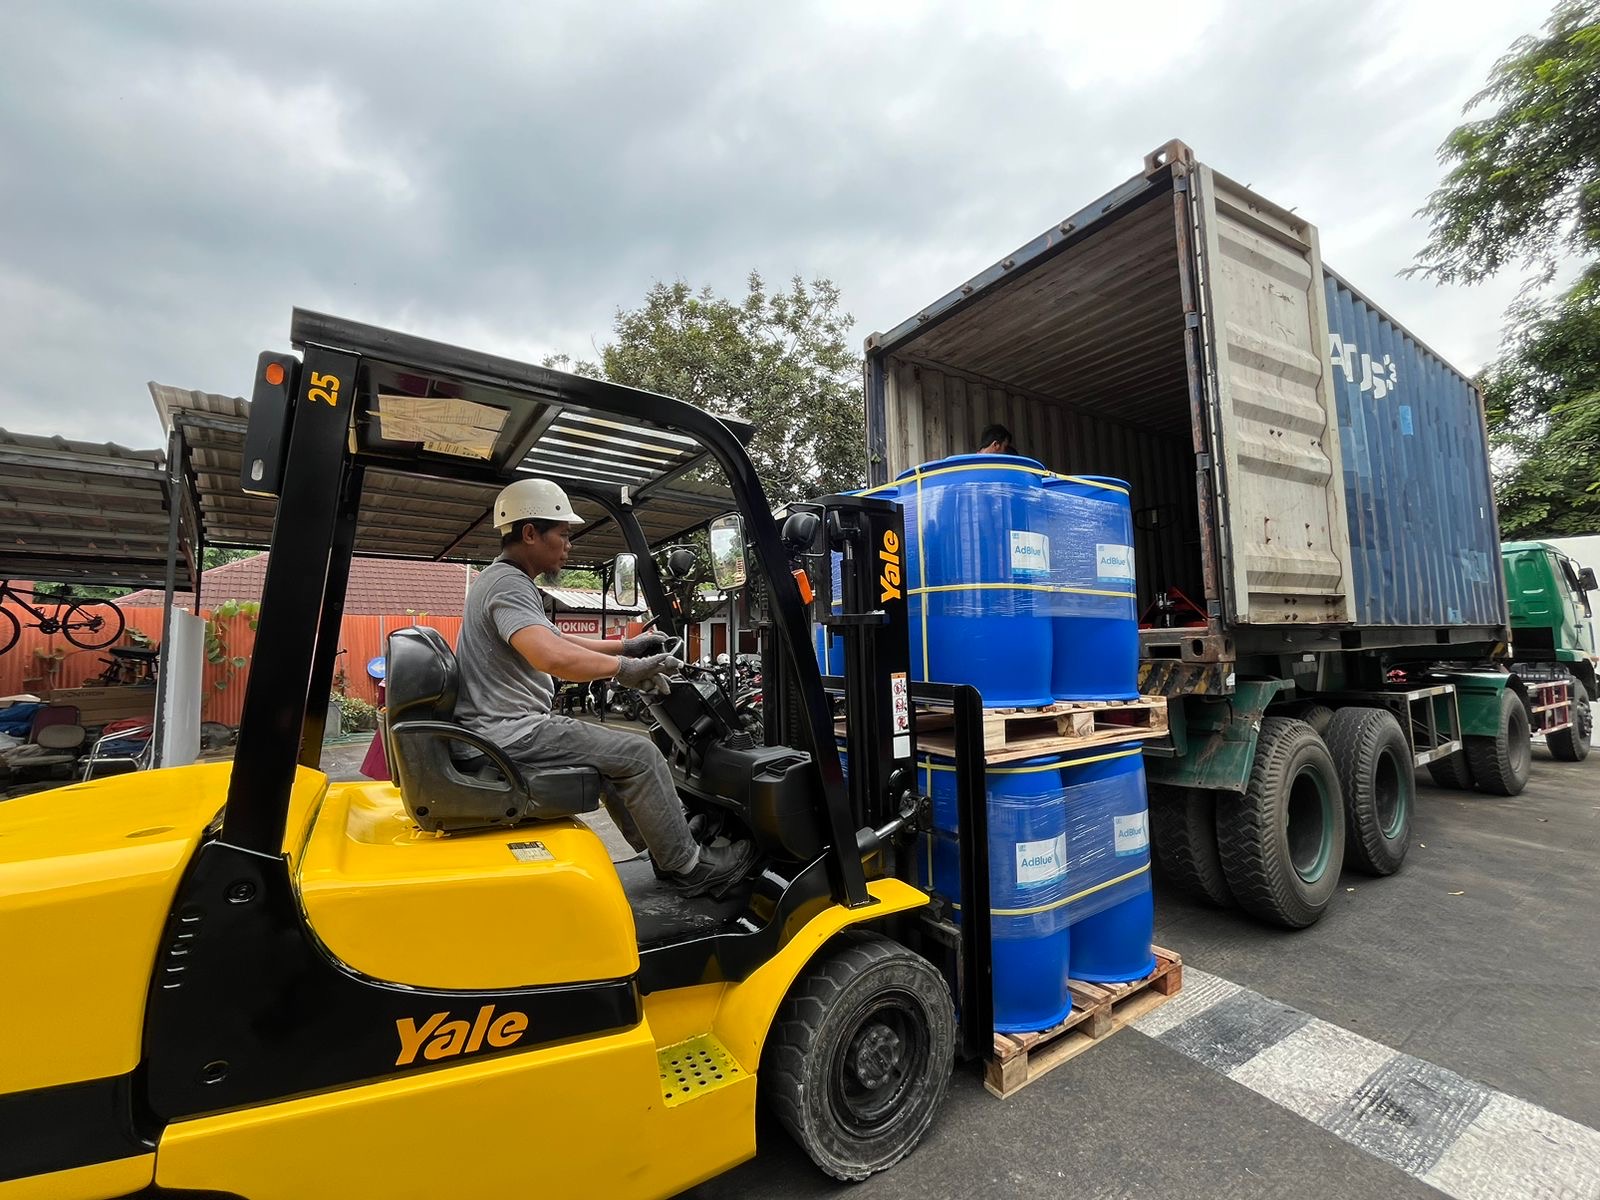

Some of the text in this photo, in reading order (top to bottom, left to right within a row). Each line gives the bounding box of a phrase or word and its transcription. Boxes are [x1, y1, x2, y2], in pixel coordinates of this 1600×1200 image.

[308, 371, 340, 407] 25
[1014, 545, 1041, 557] AdBlue
[879, 529, 902, 604] Yale
[1100, 556, 1126, 566] AdBlue
[555, 621, 596, 632] MOKING
[1119, 827, 1142, 839] AdBlue
[1021, 855, 1053, 868] AdBlue
[395, 1004, 529, 1066] Yale
